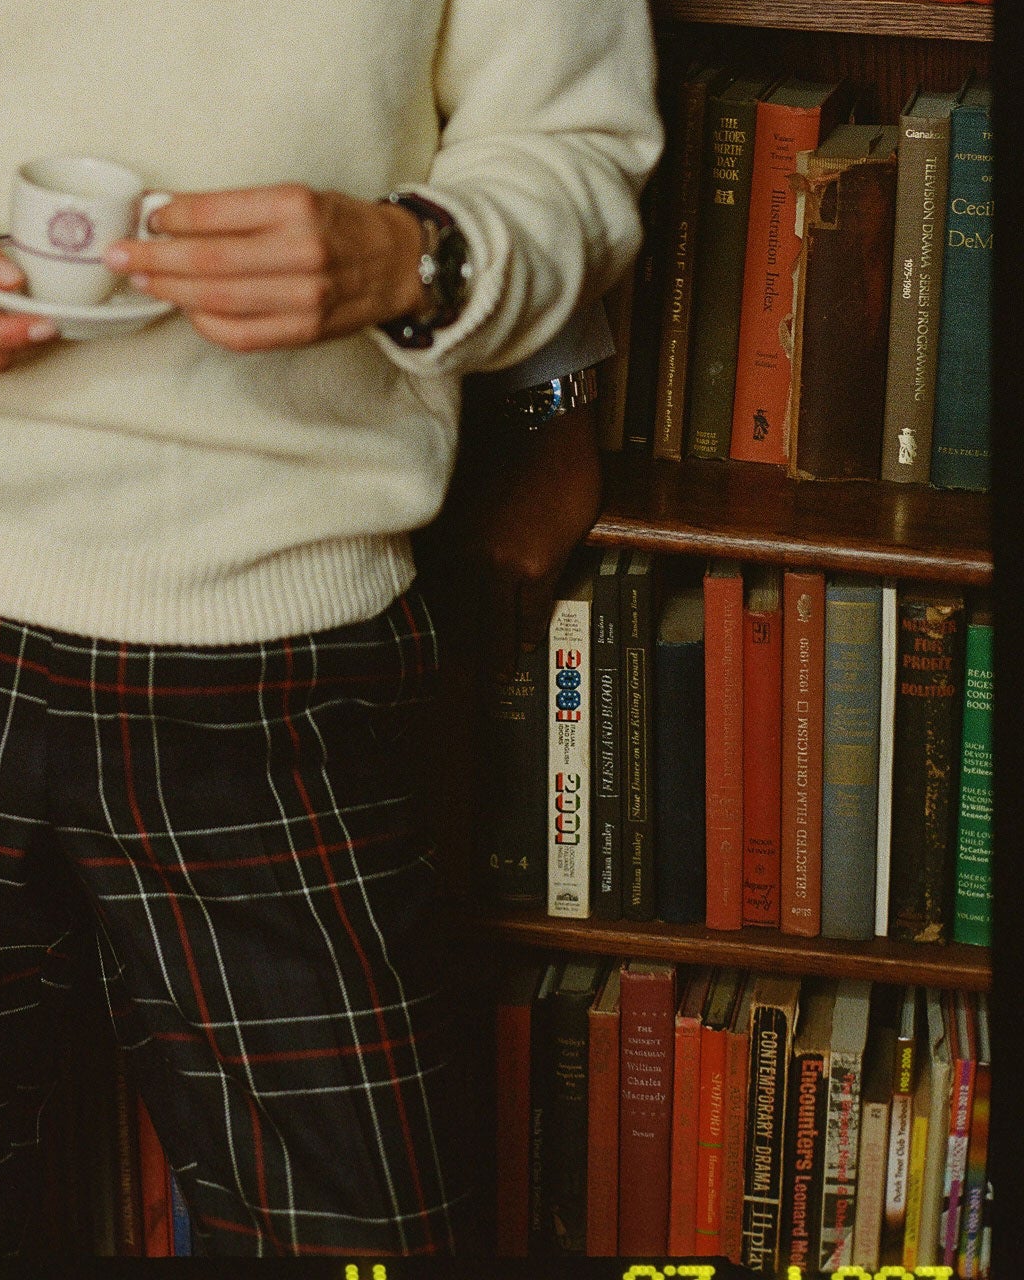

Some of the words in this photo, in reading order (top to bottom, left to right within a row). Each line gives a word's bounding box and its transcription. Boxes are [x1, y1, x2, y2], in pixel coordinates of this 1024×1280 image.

[720, 117, 738, 129] THE
[713, 168, 739, 181] BOOK
[716, 156, 737, 168] DAY
[924, 156, 939, 221] TELEVISION
[950, 198, 995, 218] Cecil
[766, 189, 786, 265] Illustration
[921, 224, 935, 268] DRAMA
[762, 271, 781, 312] Index
[902, 258, 913, 300] 1975-1980
[919, 273, 932, 309] SERIES
[672, 278, 686, 324] BOOK
[914, 310, 931, 402] PROGRAMMING
[629, 651, 640, 690] Ground
[902, 655, 952, 672] PROFIT
[556, 649, 581, 723] 2001
[601, 673, 613, 718] BLOOD
[901, 683, 955, 698] BOLITHO
[630, 692, 641, 728] Killing
[601, 721, 613, 749] AND
[631, 731, 640, 745] the
[964, 742, 985, 751] SUCH
[633, 747, 640, 759] on
[796, 717, 810, 788] CRITICISM
[601, 751, 614, 792] FLESH
[631, 762, 641, 791] Dance
[632, 794, 641, 818] Slow
[796, 791, 809, 825] FILM
[962, 787, 986, 795] RULES
[555, 772, 581, 846] 2001
[961, 811, 992, 821] Kennedy
[601, 822, 614, 855] Hanley
[632, 831, 644, 865] Hanley
[960, 837, 985, 846] CHILD
[601, 856, 612, 893] William
[795, 829, 809, 899] SELECTED
[959, 853, 989, 863] Cookson
[632, 868, 642, 905] William
[958, 881, 987, 890] GOTHIC
[626, 1061, 662, 1073] William
[627, 1077, 662, 1087] Charles
[899, 1047, 912, 1093] 1905-2006
[622, 1089, 666, 1102] Macready
[755, 1031, 778, 1139] CONTEMPORARY
[709, 1072, 722, 1137] SPOFFORD
[795, 1059, 824, 1171] Encounters
[898, 1099, 909, 1136] Yearbook
[896, 1138, 906, 1157] Club
[753, 1145, 773, 1192] DRAMA
[895, 1157, 905, 1177] Treat
[792, 1175, 812, 1236] Leonard
[893, 1180, 903, 1203] Dutch
